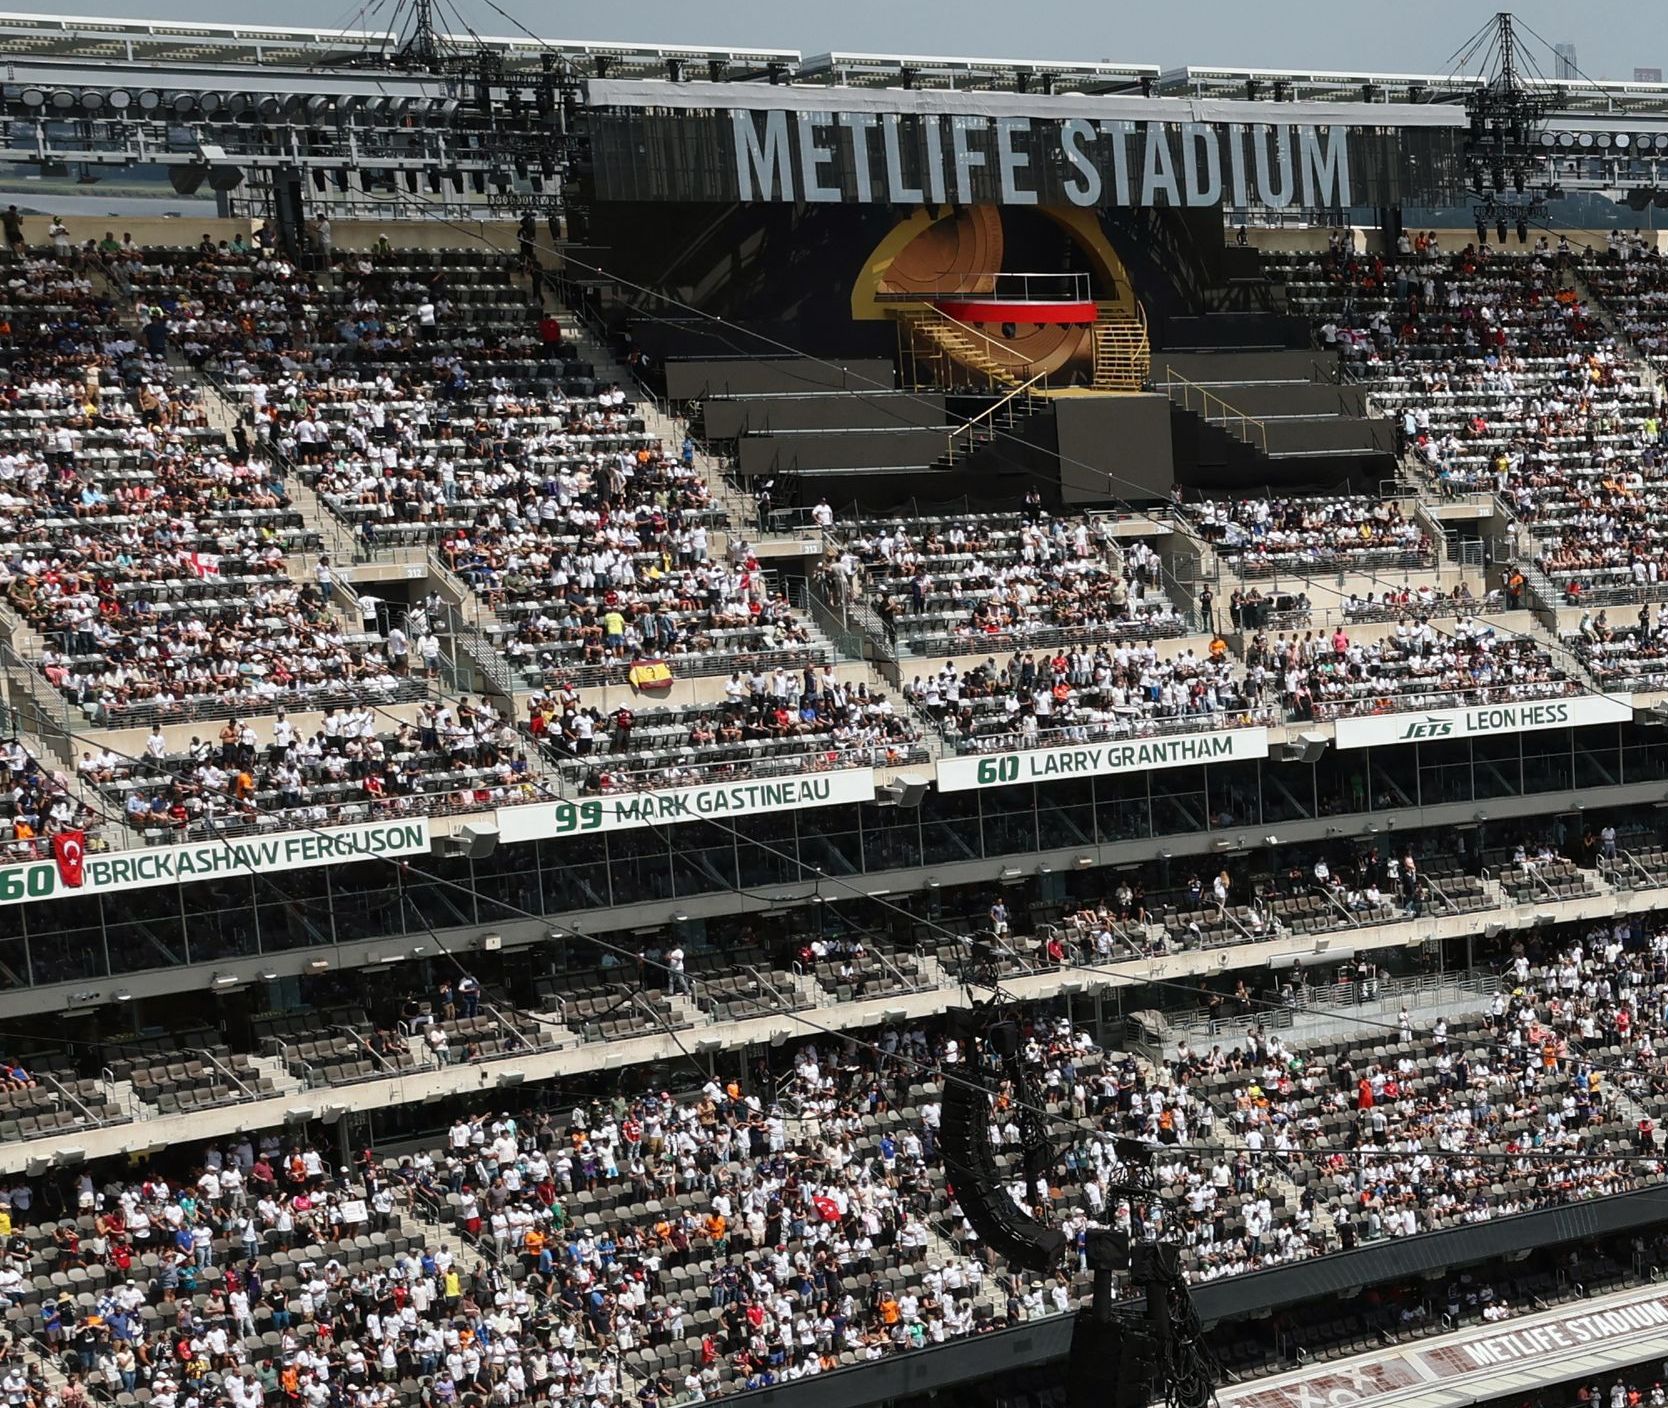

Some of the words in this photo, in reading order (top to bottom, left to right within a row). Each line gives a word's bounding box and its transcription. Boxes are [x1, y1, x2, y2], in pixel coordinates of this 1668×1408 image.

[736, 108, 1038, 204] METLIFE
[1062, 117, 1351, 208] STADIUM
[407, 568, 422, 577] 312
[1399, 717, 1453, 740] JETS
[1466, 708, 1516, 732] LEON
[1521, 703, 1568, 726] HESS
[977, 755, 1020, 785] 60
[1030, 748, 1102, 776] LARRY
[1107, 735, 1233, 768] GRANTHAM
[554, 800, 602, 833] 99
[615, 793, 690, 824] MARK
[696, 778, 830, 814] GASTINEAU
[0, 865, 55, 901] 60
[82, 840, 279, 887] 'BRICKASHAW
[285, 824, 424, 862] FERGUSON
[1463, 1325, 1574, 1366] METLIFE
